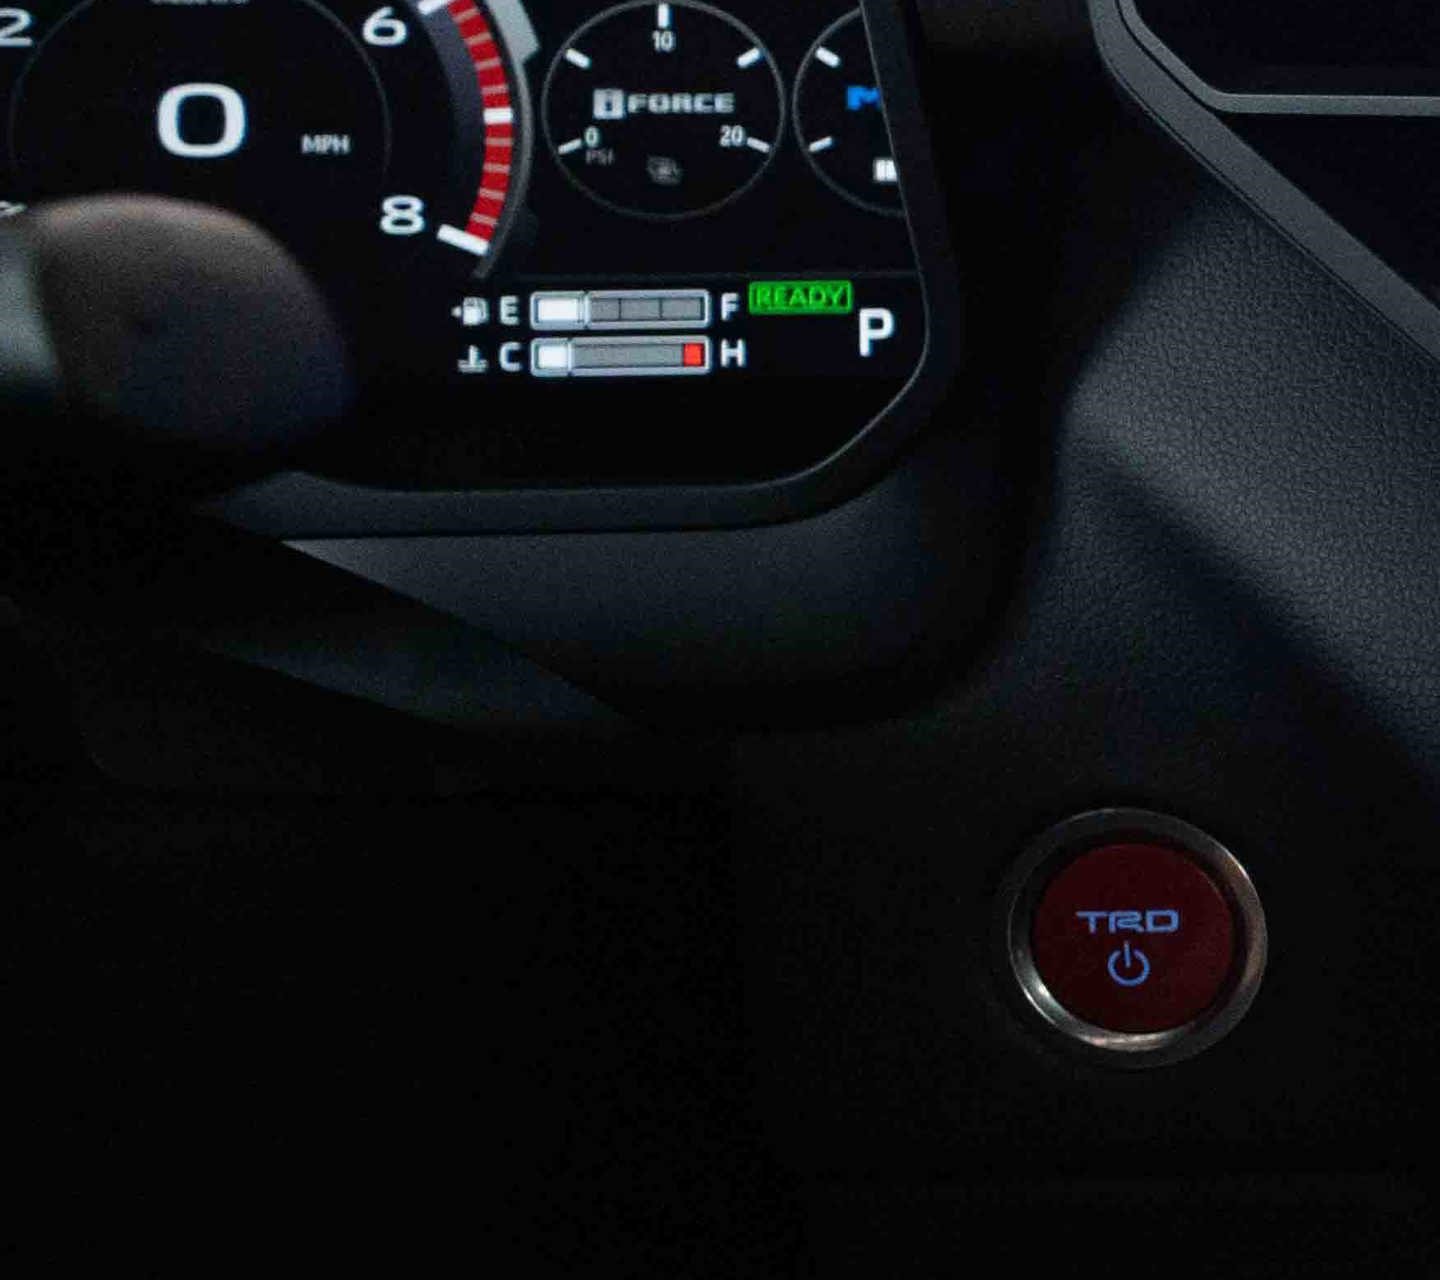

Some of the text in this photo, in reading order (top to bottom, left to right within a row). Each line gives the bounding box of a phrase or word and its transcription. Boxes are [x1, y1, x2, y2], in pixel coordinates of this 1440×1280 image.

[0, 8, 33, 47] 2
[362, 7, 407, 46] 6
[652, 30, 675, 53] 10
[157, 82, 247, 158] 0
[720, 125, 744, 147] 20
[302, 134, 350, 155] MPH
[585, 126, 600, 148] 0
[379, 196, 425, 235] 8
[500, 293, 741, 326] E F
[753, 286, 846, 308] READY
[858, 308, 894, 357] P
[499, 339, 746, 372] C H
[1075, 908, 1182, 934] TRD
